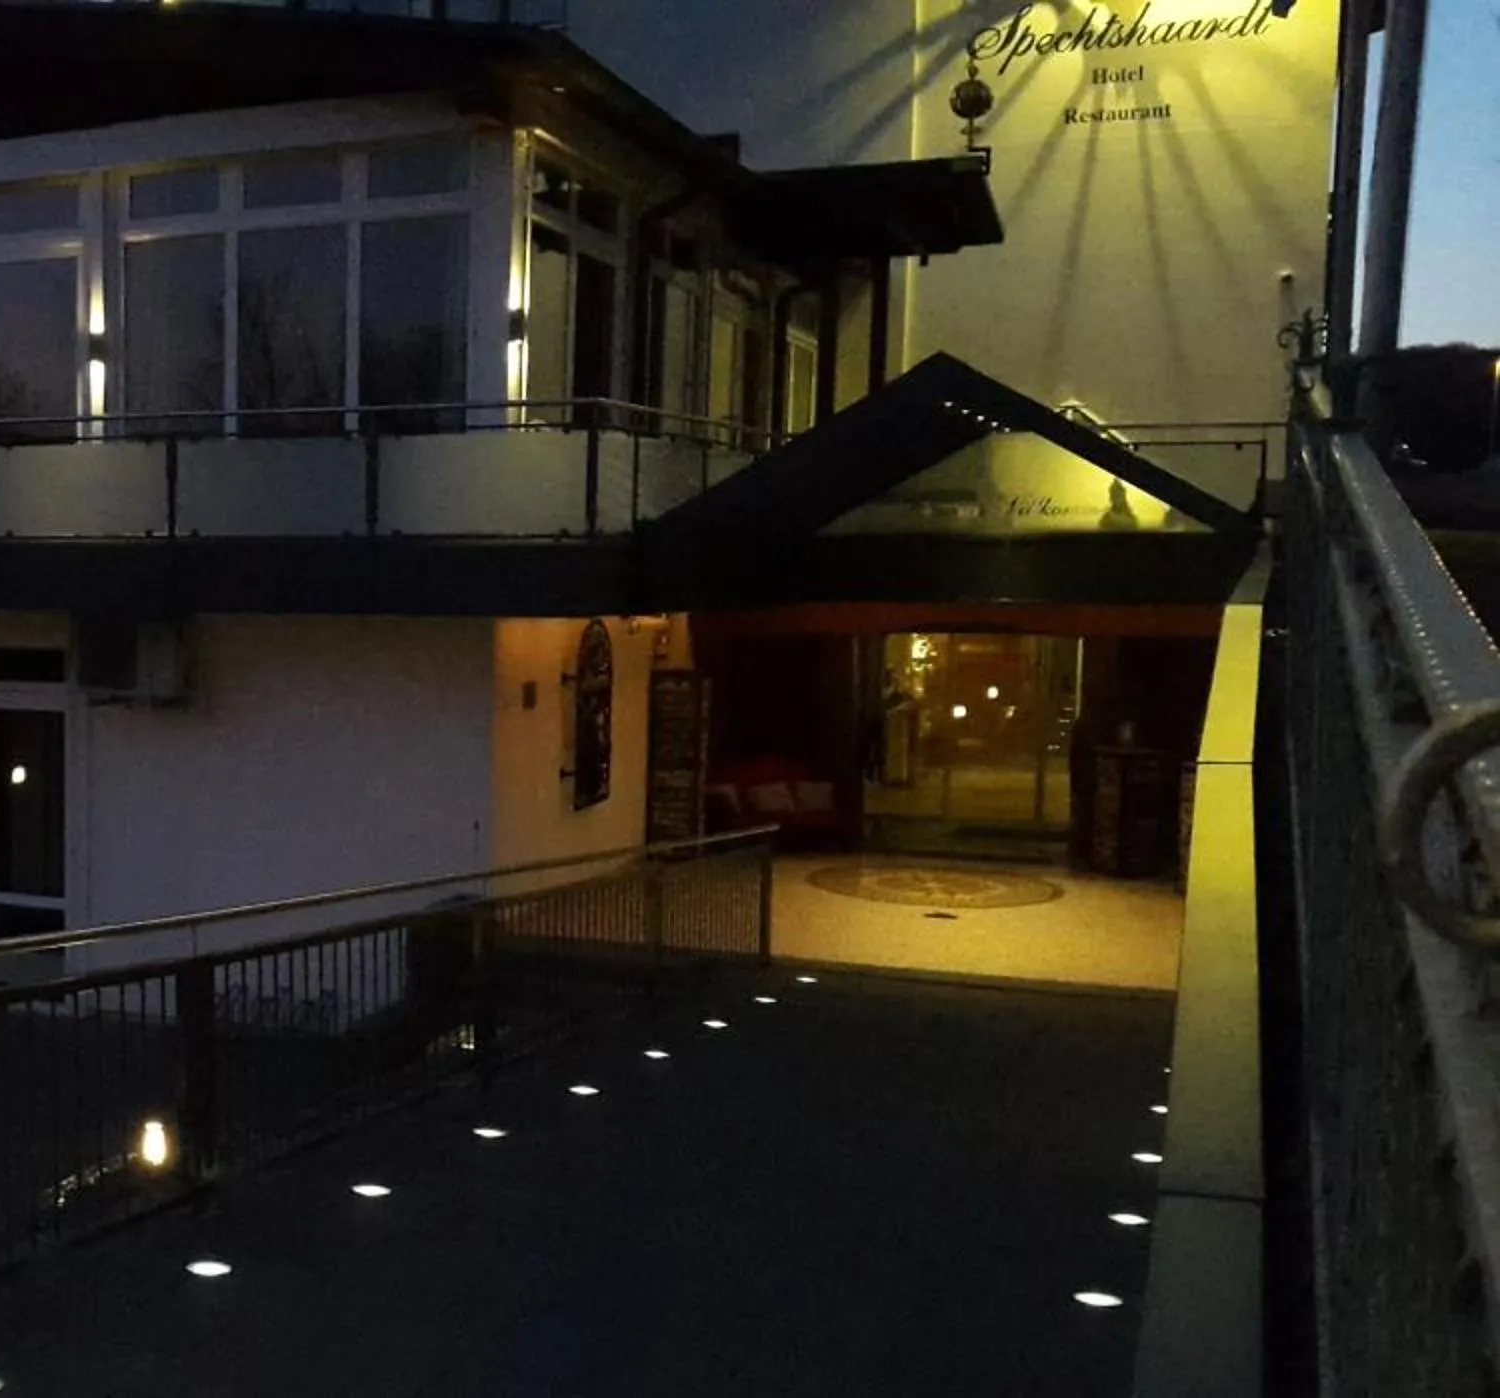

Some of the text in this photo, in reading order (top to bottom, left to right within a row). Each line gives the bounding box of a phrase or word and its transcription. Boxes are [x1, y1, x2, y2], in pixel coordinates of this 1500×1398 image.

[968, 0, 1272, 75] Spechtshaardt
[1091, 65, 1145, 85] Hotel
[1063, 103, 1172, 125] Restaurant
